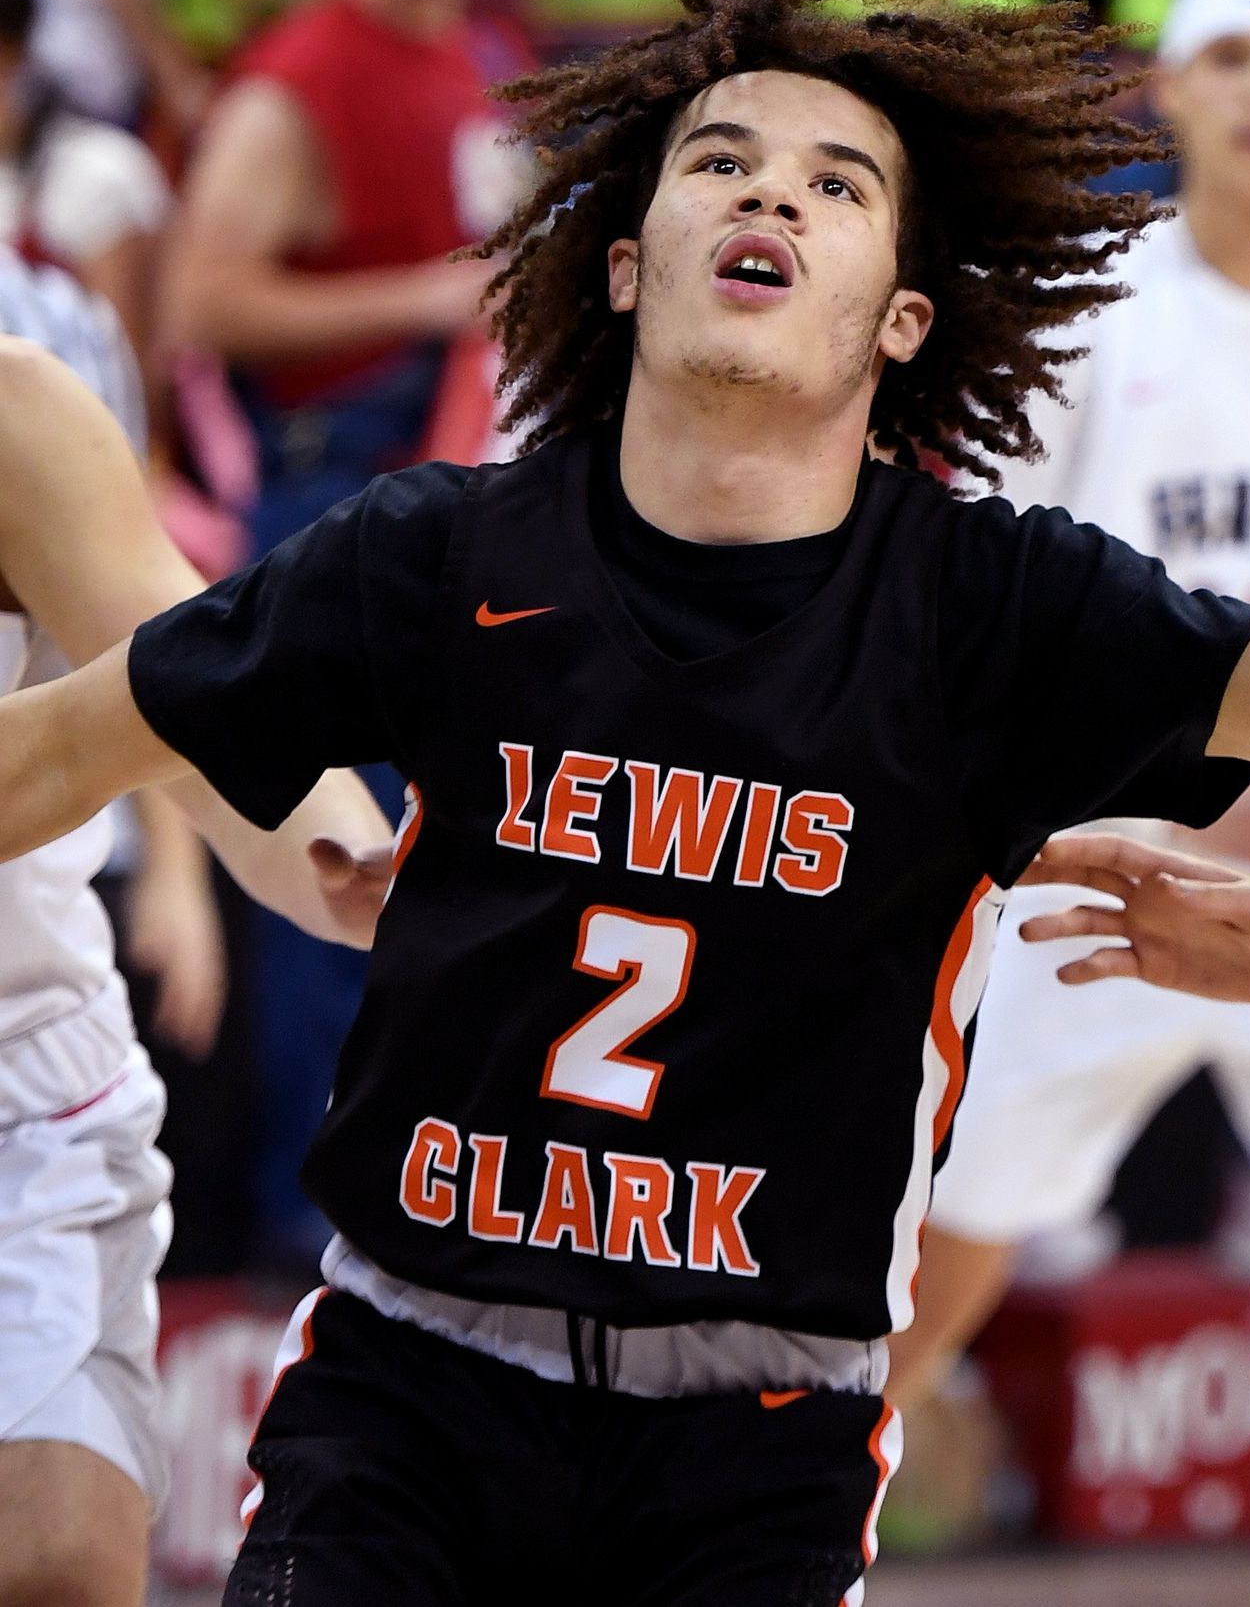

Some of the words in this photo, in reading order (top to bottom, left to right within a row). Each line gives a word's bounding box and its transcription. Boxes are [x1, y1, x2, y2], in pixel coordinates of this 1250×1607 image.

[496, 741, 855, 897] LEWIS
[539, 904, 698, 1121] 2
[399, 1116, 767, 1278] CLARK
